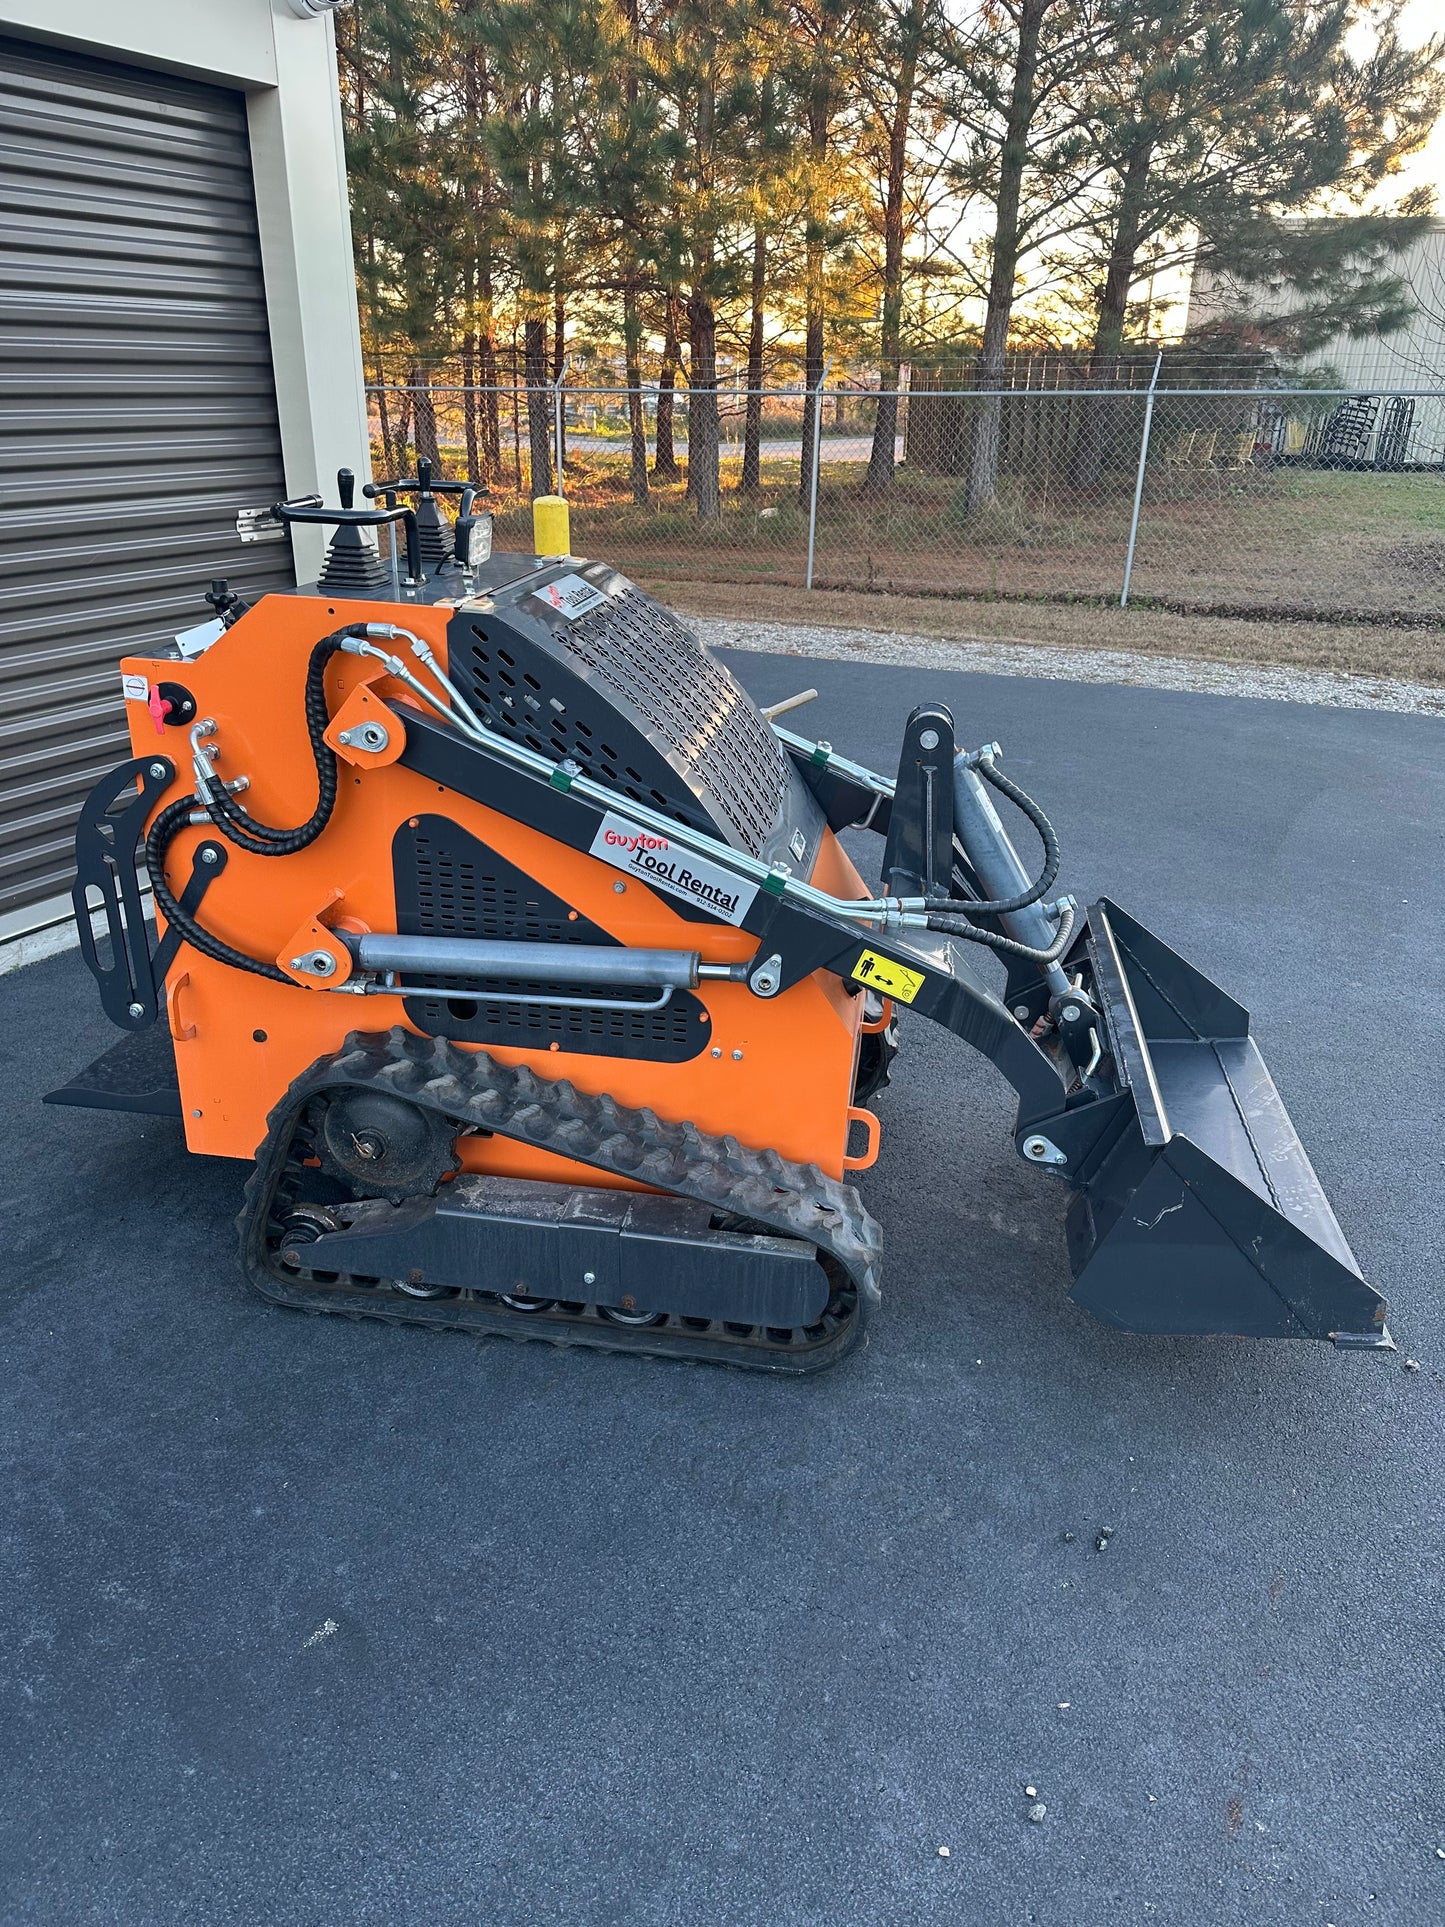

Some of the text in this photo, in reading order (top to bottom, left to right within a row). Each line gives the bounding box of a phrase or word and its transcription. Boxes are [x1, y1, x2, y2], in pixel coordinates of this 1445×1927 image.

[604, 829, 669, 852] Guyton
[628, 863, 733, 918] GuytonToolRental.com 912-514-0202
[635, 847, 740, 910] Tool Rental
